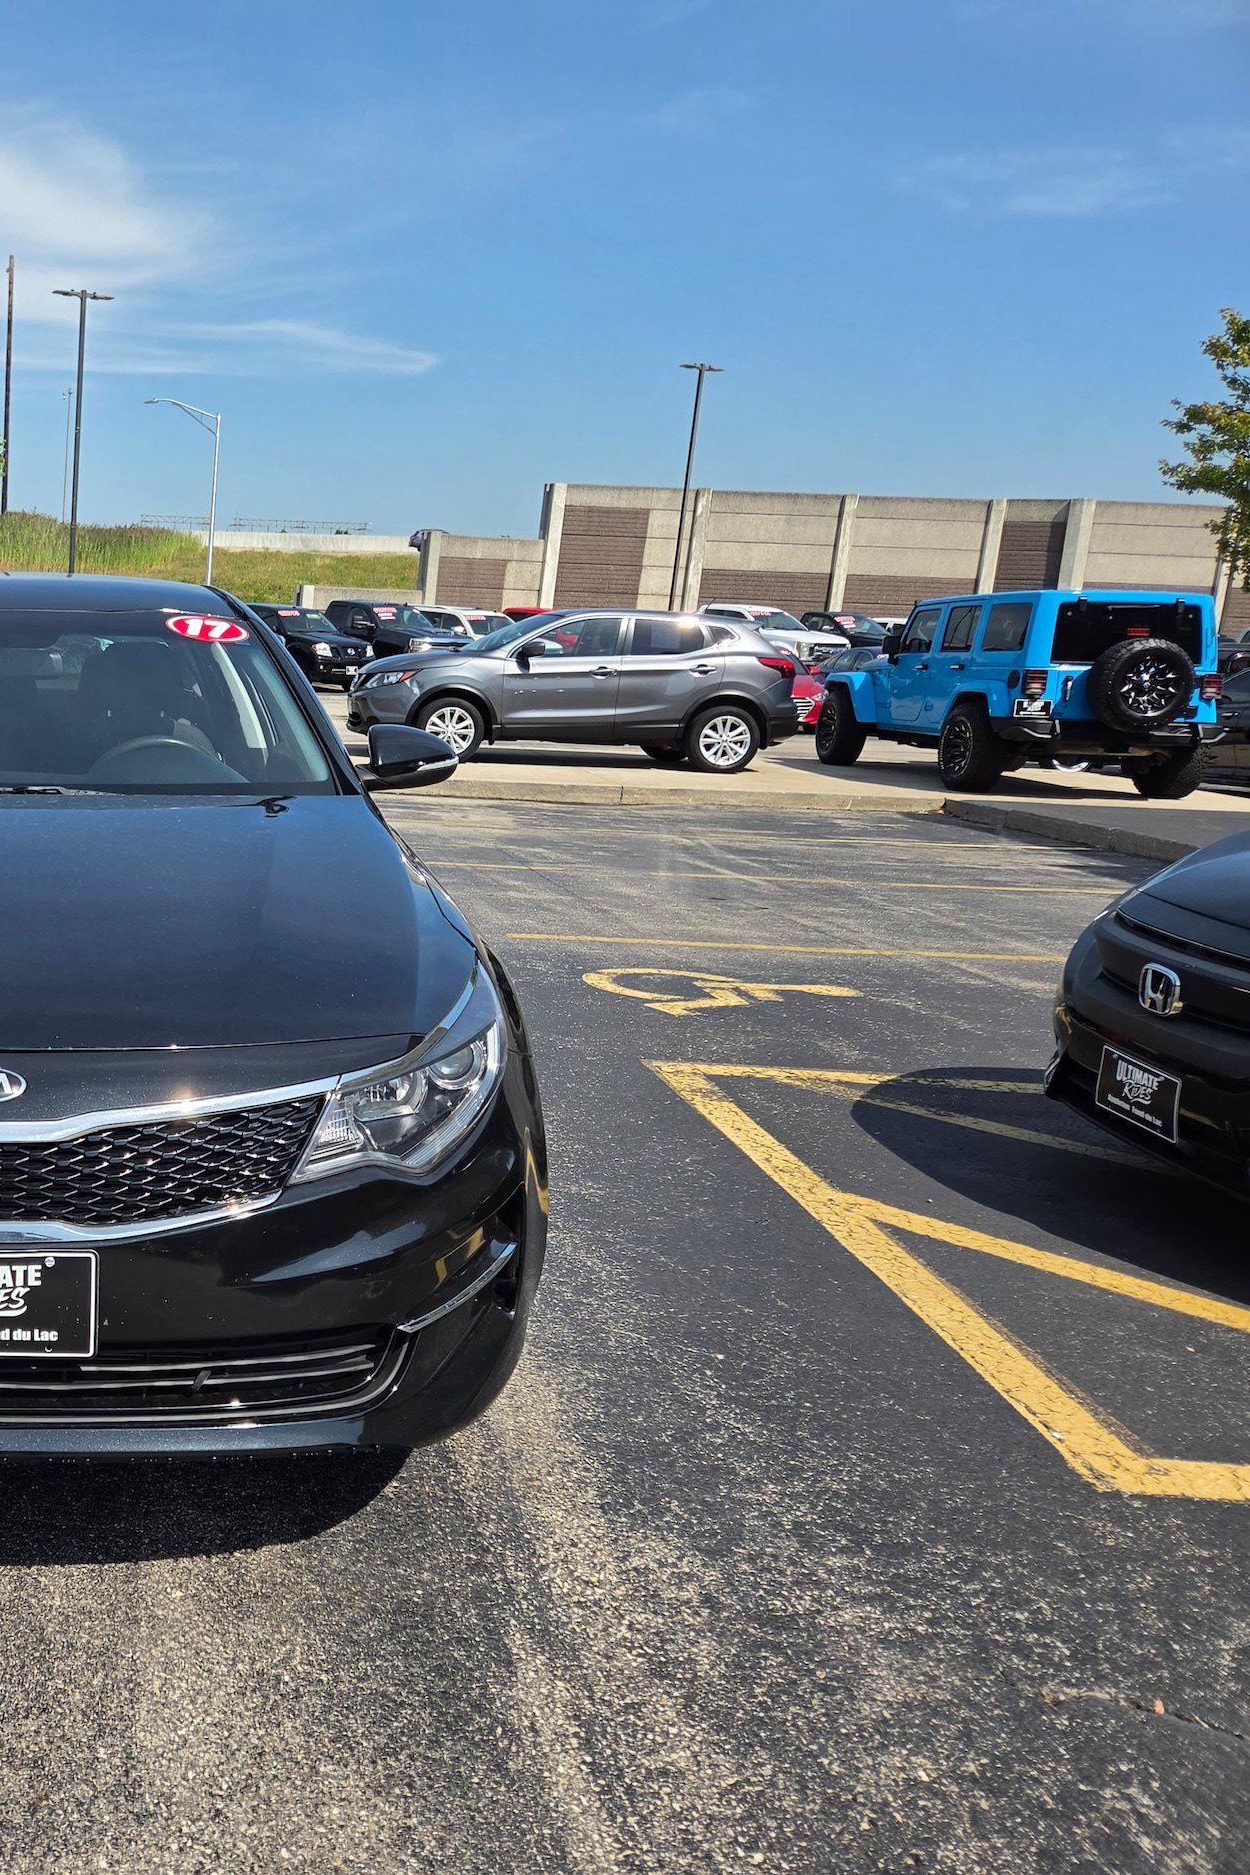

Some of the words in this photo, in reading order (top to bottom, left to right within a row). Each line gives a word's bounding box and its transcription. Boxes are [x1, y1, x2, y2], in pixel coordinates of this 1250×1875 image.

[184, 618, 231, 638] 17
[1116, 1060, 1159, 1091] ULTIMATE
[12, 1328, 32, 1341] du
[33, 1329, 59, 1342] Lac
